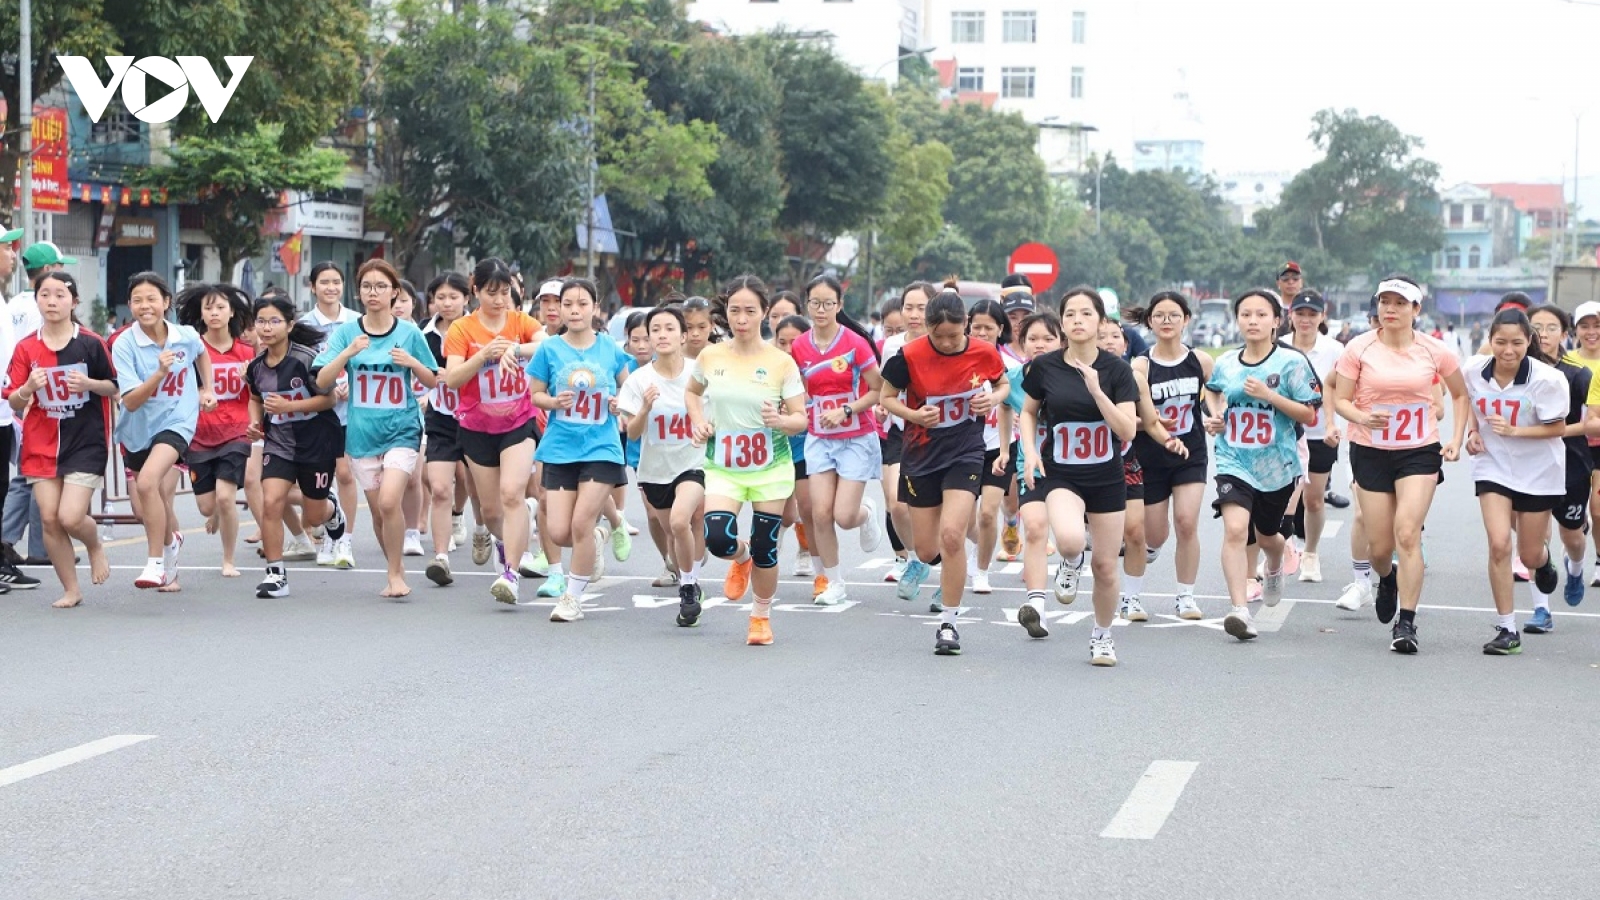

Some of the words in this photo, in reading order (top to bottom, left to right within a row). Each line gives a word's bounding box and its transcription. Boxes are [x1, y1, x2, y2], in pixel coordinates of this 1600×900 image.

[44, 370, 84, 402] 15
[357, 373, 404, 404] 170
[484, 366, 527, 399] 148
[1058, 424, 1109, 460] 130
[1228, 411, 1273, 445] 125
[721, 431, 768, 468] 138
[314, 471, 329, 489] 10
[1564, 503, 1583, 521] 22
